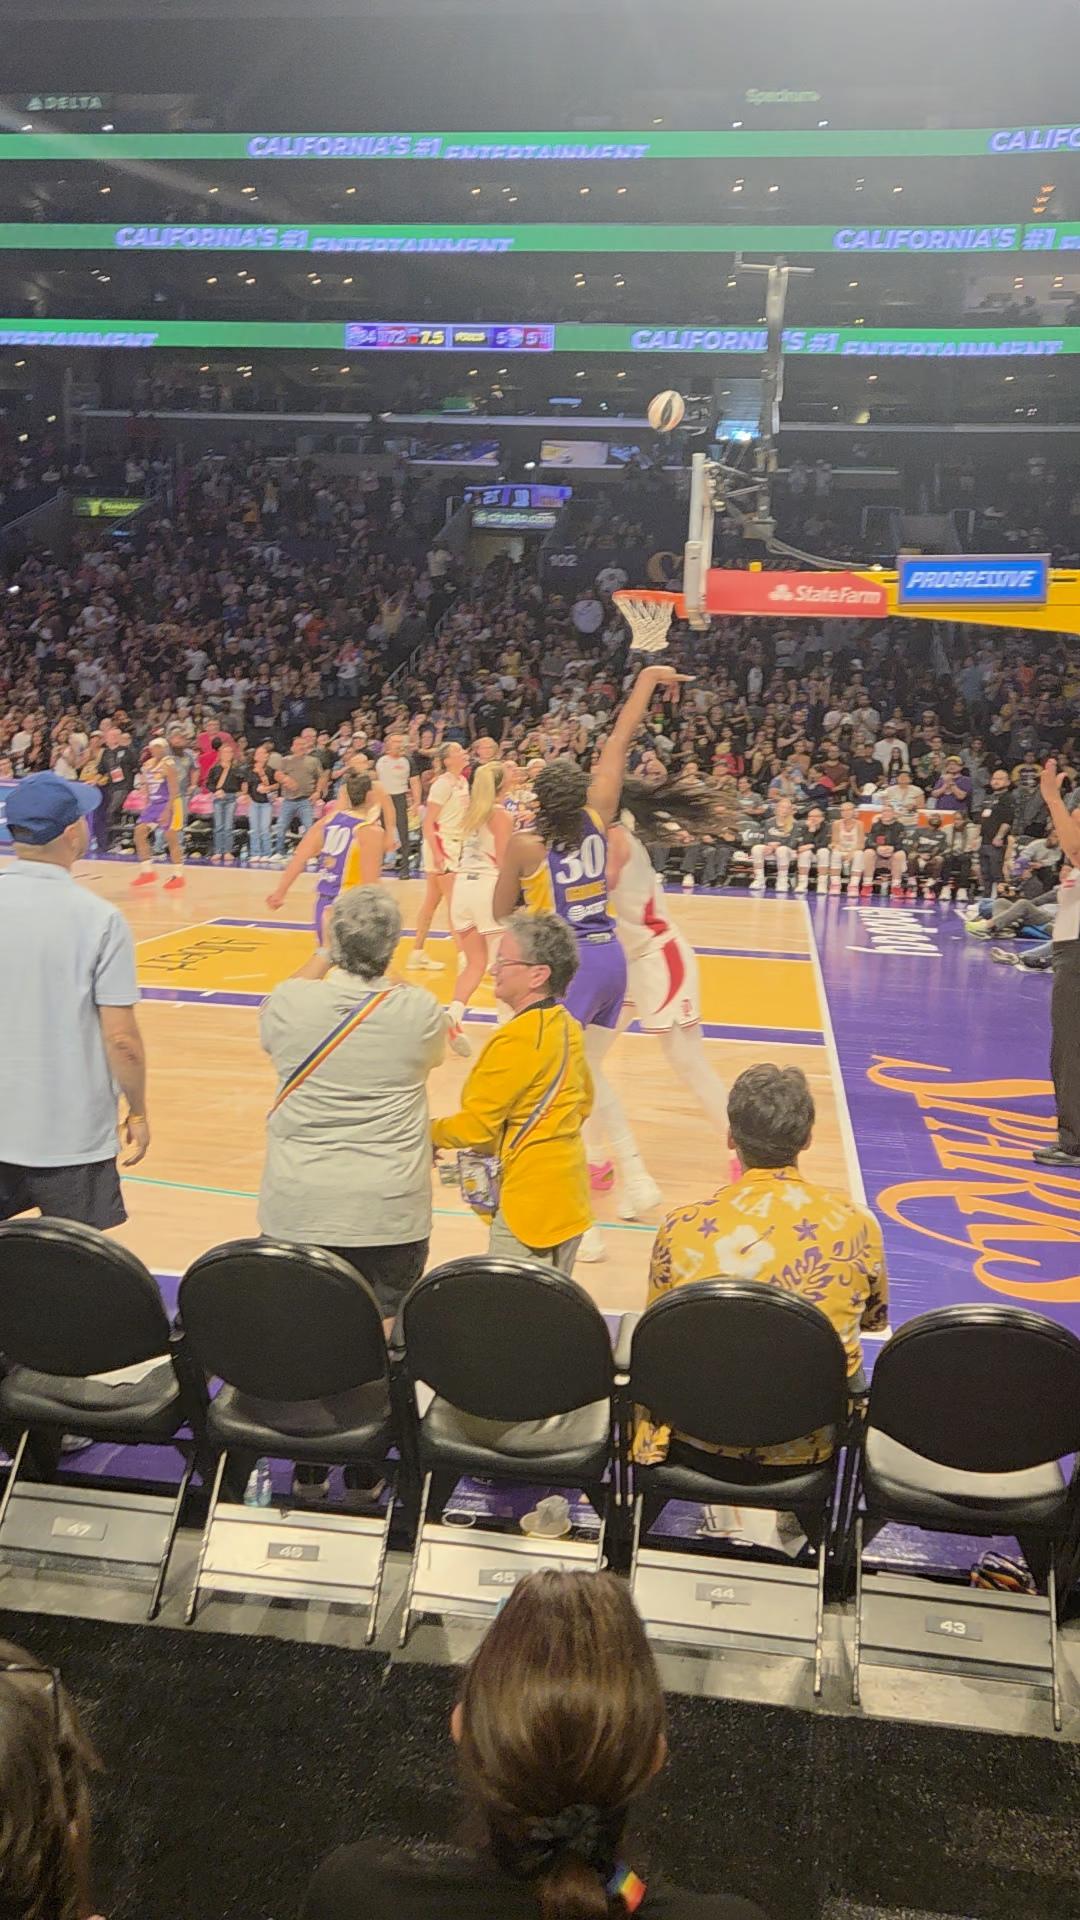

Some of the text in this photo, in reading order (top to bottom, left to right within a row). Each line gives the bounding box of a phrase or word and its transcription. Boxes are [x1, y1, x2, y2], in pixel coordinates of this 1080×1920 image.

[44, 96, 102, 110] DELTA
[247, 136, 412, 157] CALIFORNIA'S
[413, 137, 442, 158] #1
[115, 227, 278, 248] CALIFORNIA'S
[280, 229, 309, 249] #1
[833, 227, 1017, 250] CALIFORNIA'S
[1022, 227, 1056, 250] #1
[631, 329, 806, 351] CALIFORNI'S
[807, 332, 840, 353] #1
[906, 570, 1038, 589] PROGRESSIVE
[321, 825, 351, 857] 10
[492, 1571, 516, 1583] 45
[940, 1620, 966, 1635] 43
